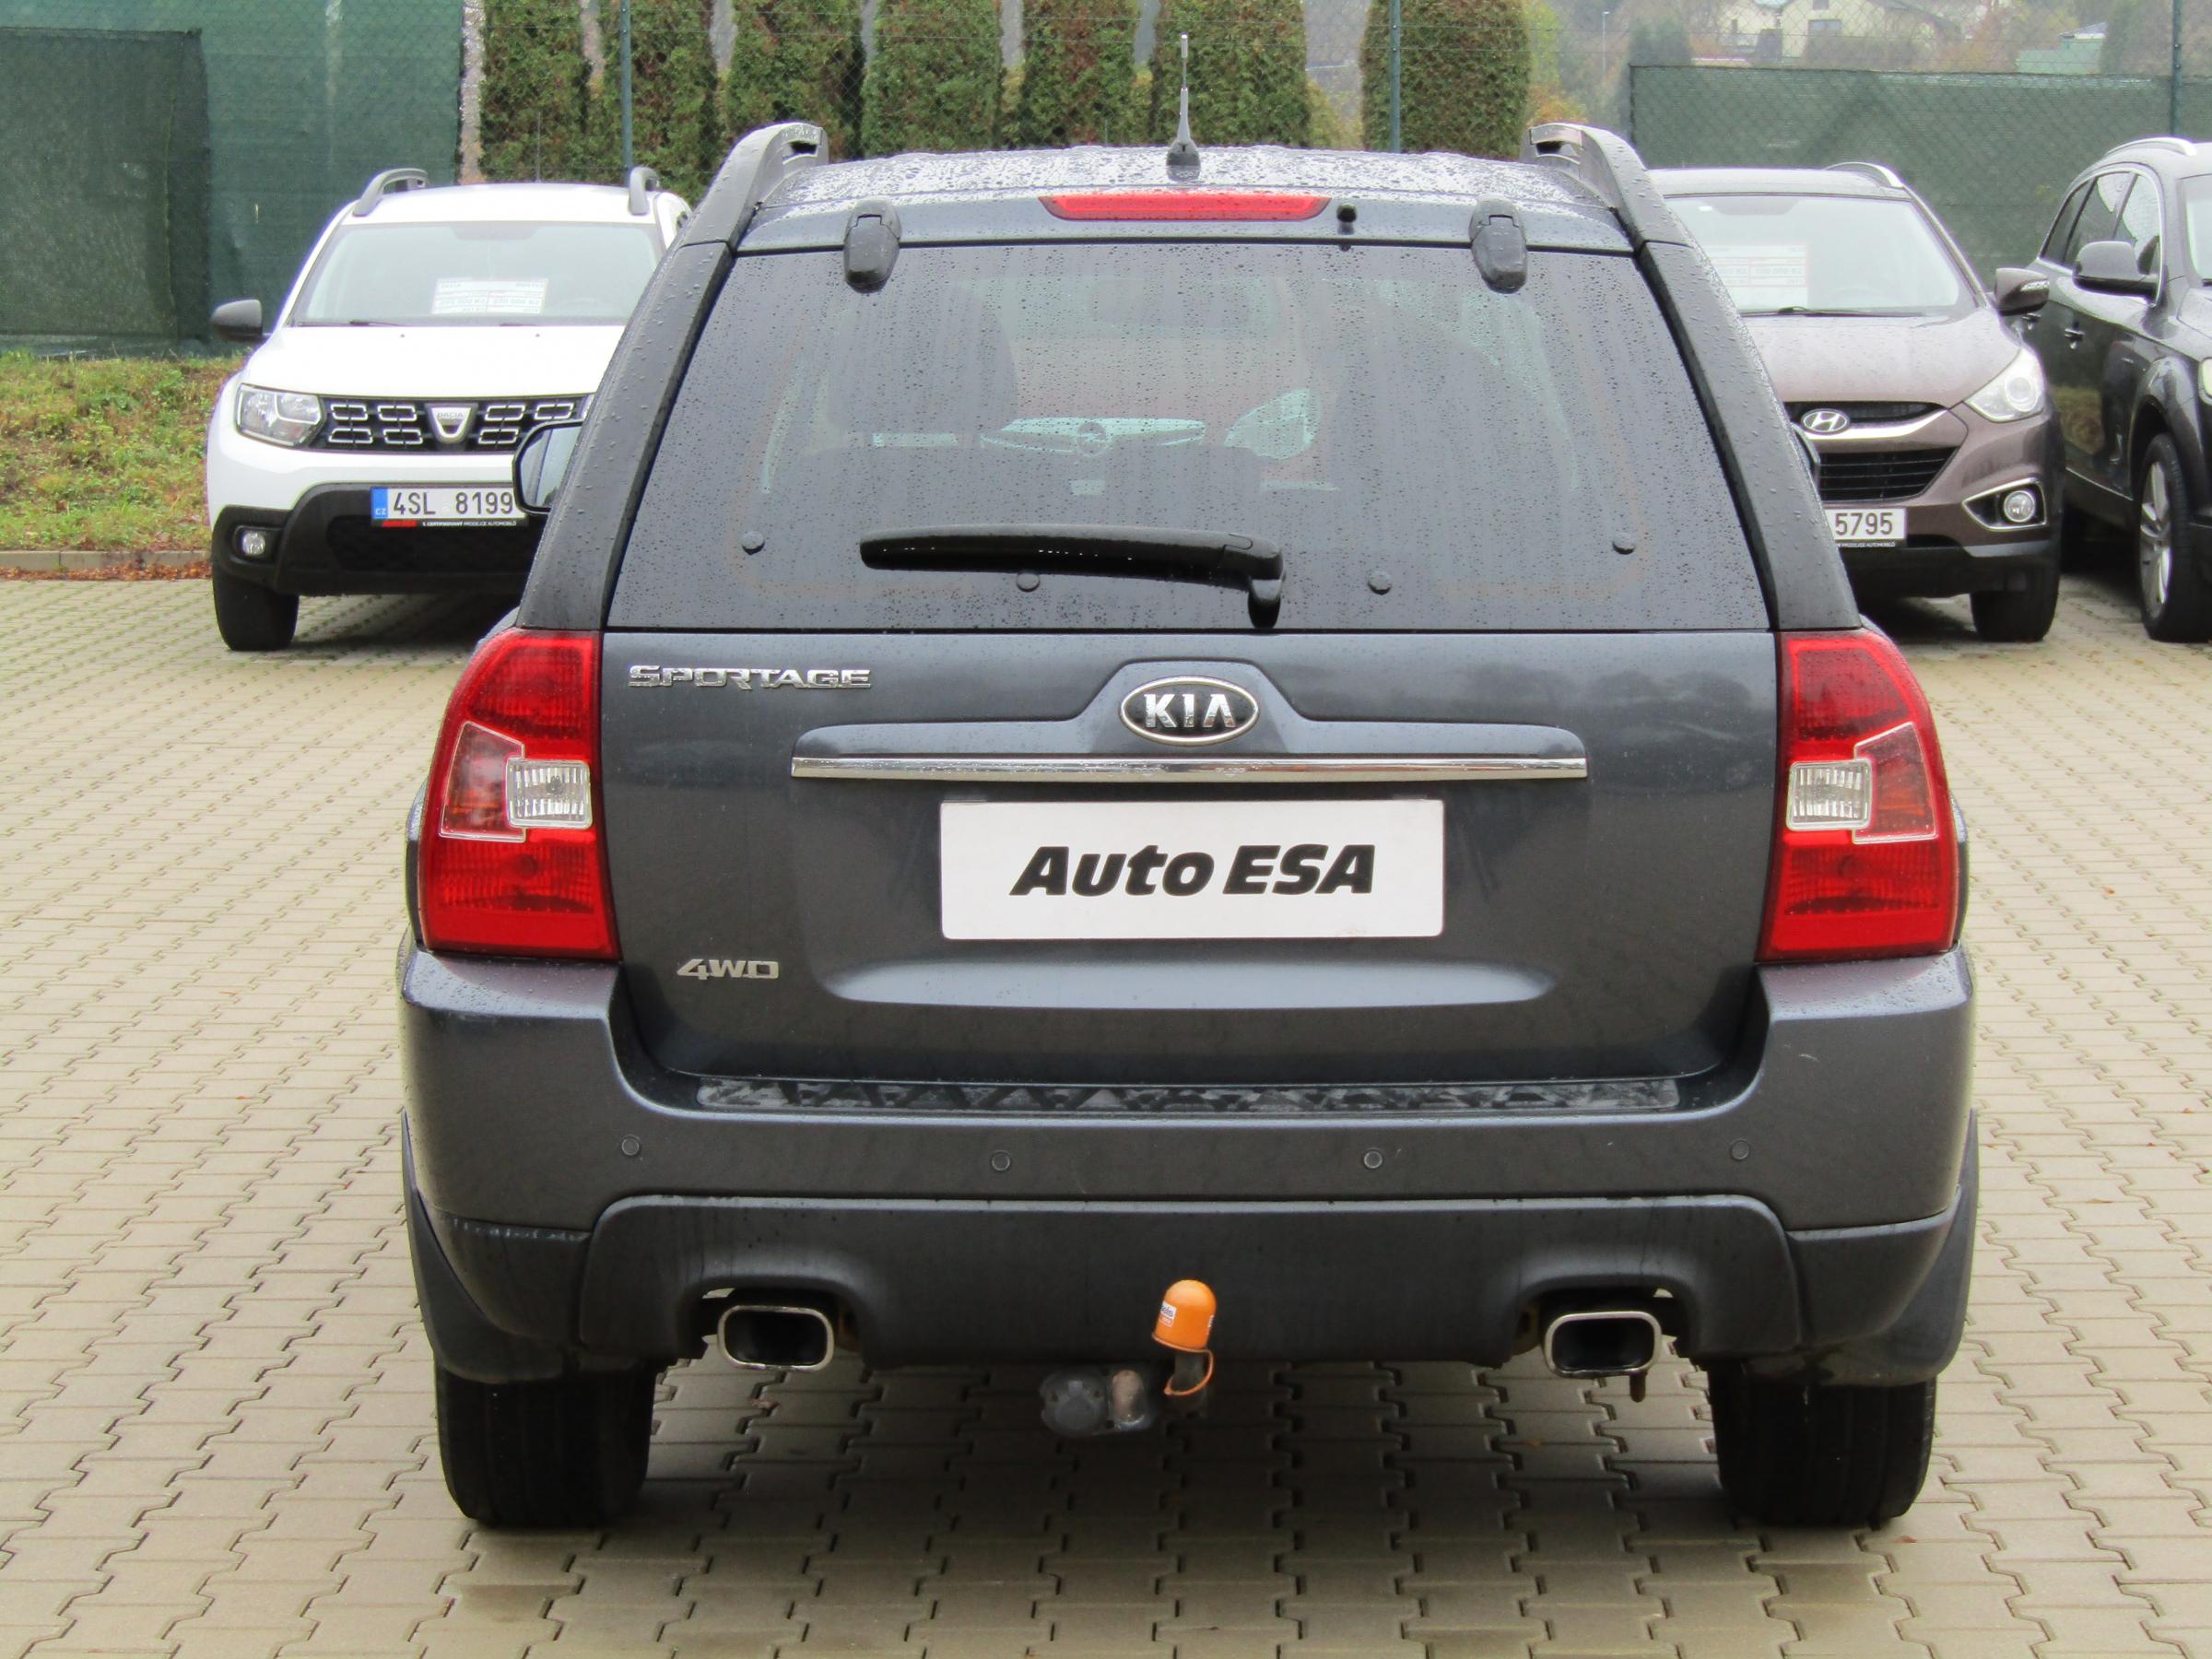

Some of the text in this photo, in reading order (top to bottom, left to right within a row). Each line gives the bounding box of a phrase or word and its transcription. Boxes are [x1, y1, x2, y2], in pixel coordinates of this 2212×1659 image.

[394, 492, 436, 515] 4SL
[455, 491, 513, 515] 8199
[1835, 512, 1893, 535] 5795
[629, 665, 871, 690] SPORTAGE
[1143, 694, 1236, 728] KIA
[1009, 843, 1375, 897] Auto ESA
[677, 959, 779, 980] 4WD
